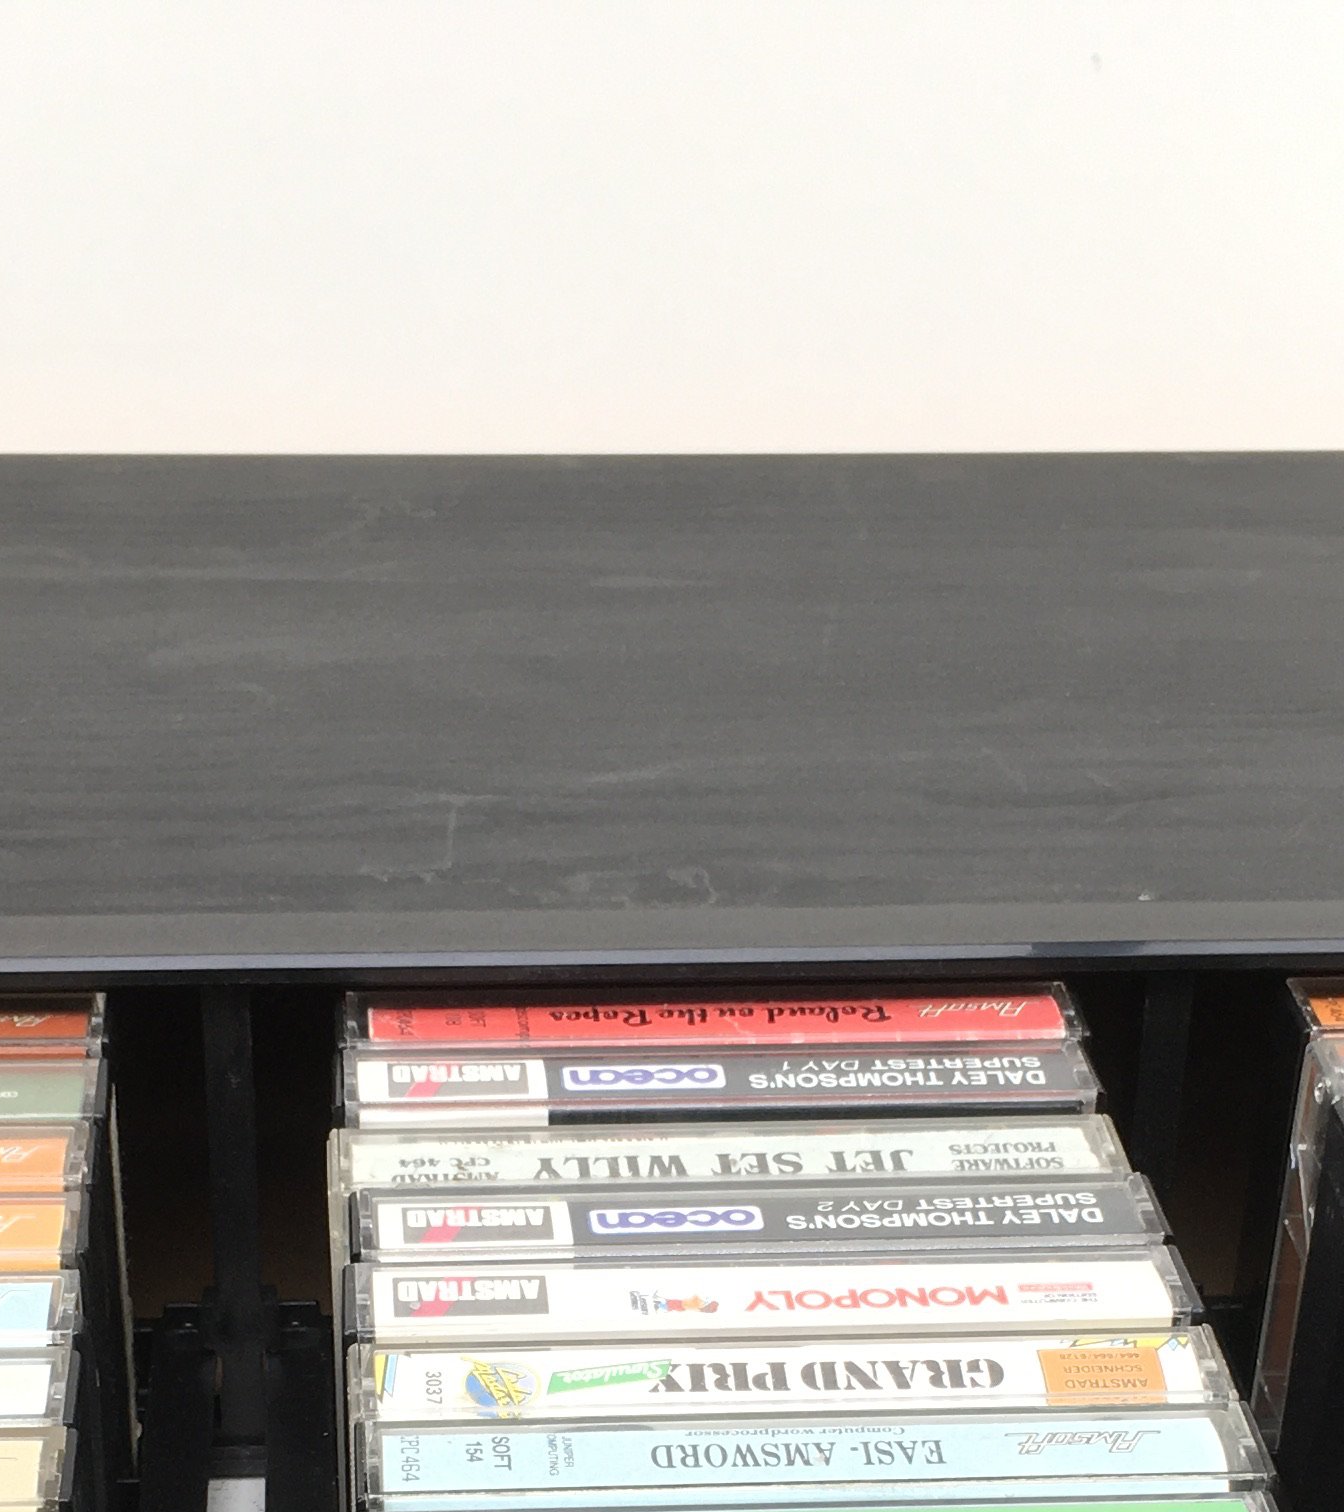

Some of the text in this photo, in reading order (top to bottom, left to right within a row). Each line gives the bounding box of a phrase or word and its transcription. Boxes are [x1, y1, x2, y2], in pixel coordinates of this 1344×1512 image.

[548, 1002, 891, 1026] Roland on the Ropes
[392, 1064, 520, 1083] AMSTRAD
[781, 1058, 1041, 1072] SUPERTEST DAY 1
[571, 1067, 718, 1087] ocean
[749, 1070, 1044, 1087] DALEY THOMPSON'S
[949, 1141, 1056, 1155] PROJECTS
[531, 1148, 914, 1179] JET SET WILLY
[952, 1155, 1064, 1171] SOFTWARE
[817, 1191, 1096, 1212] SUPERTEST DAY 2
[405, 1208, 546, 1228] AMSTRAD
[597, 1208, 754, 1230] ocean
[787, 1207, 1103, 1230] DALEY THOMPSON'S
[397, 1280, 539, 1302] AMSTRAD
[746, 1285, 1007, 1311] MONOPOLY
[648, 1356, 1005, 1394] GRAND PRIX
[427, 1371, 441, 1404] 3037
[1004, 1430, 1160, 1456] Amsoft
[651, 1440, 946, 1471] EASI- AMSWORD
